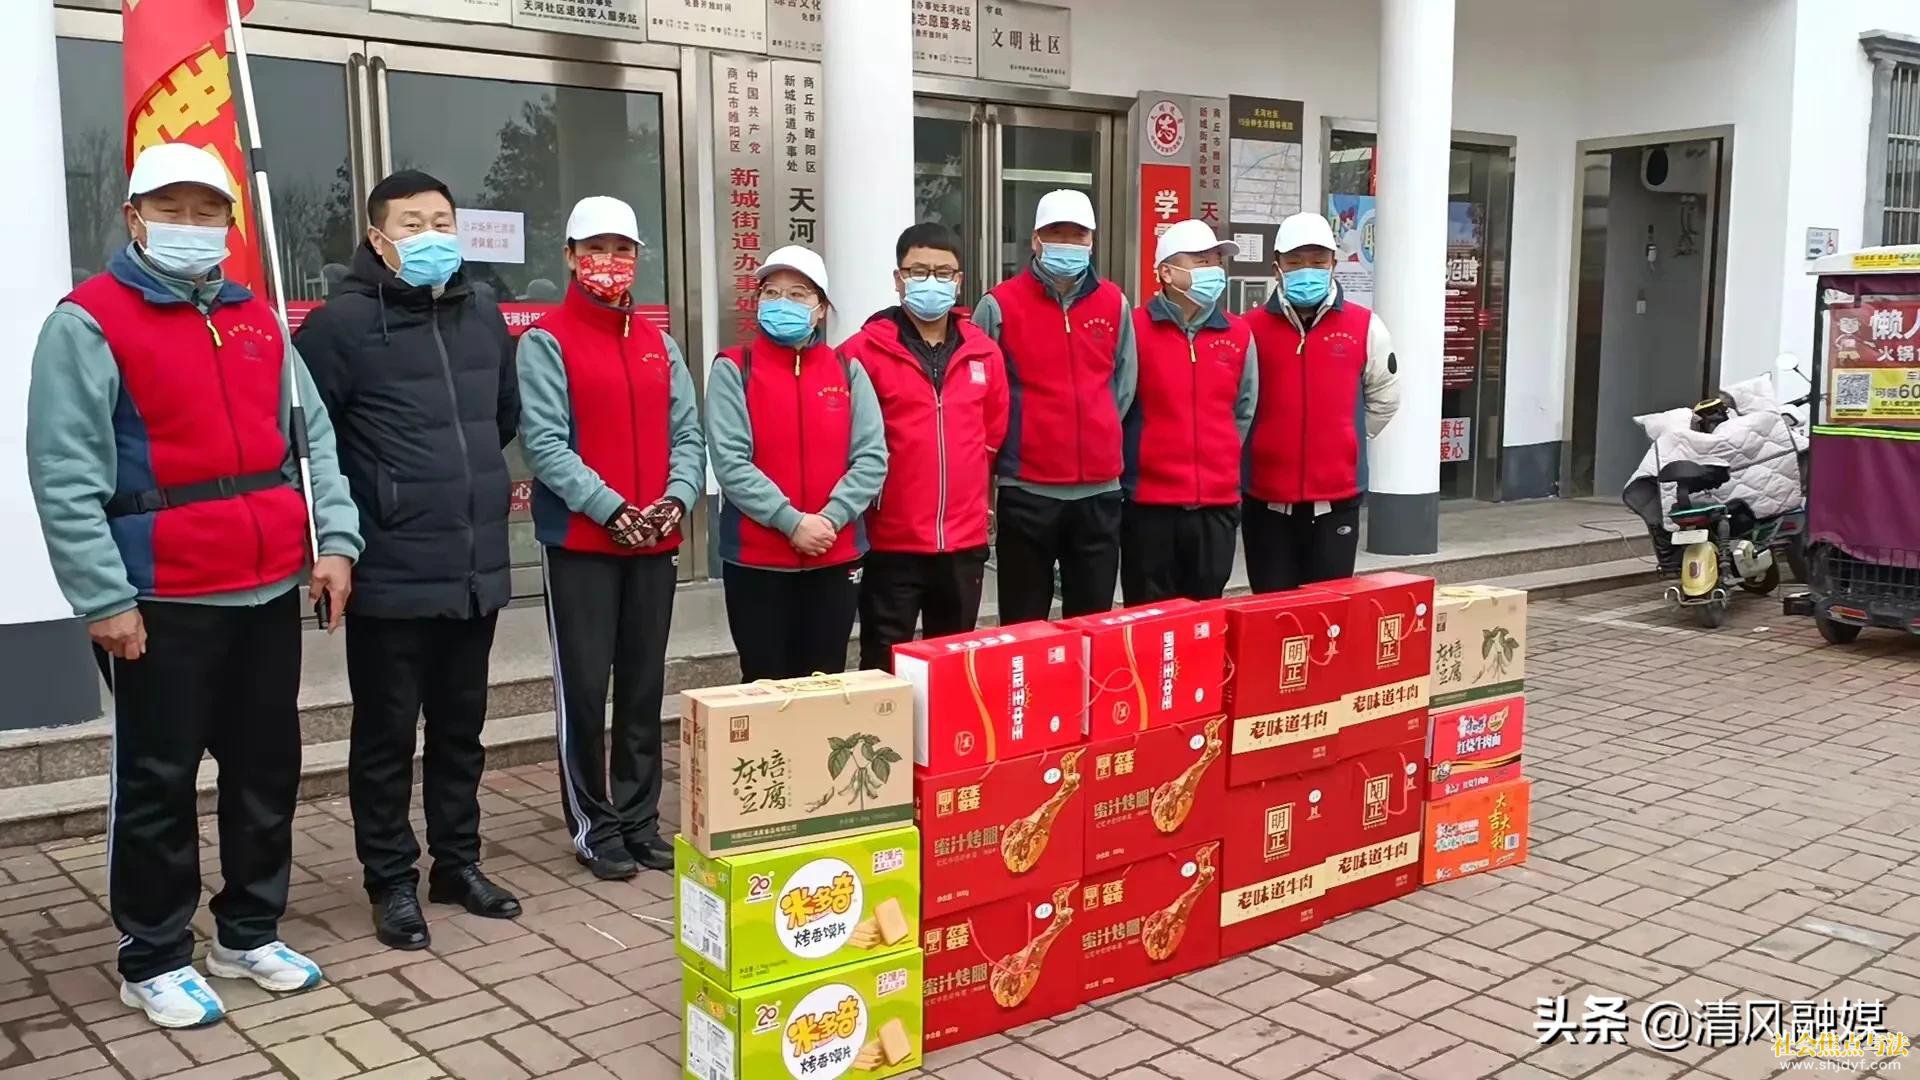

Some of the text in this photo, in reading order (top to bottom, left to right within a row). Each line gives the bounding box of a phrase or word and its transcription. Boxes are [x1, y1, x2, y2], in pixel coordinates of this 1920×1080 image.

[912, 13, 972, 32] 志愿服务站
[913, 29, 949, 40] 费开放时间
[992, 28, 1061, 54] 文明社区
[747, 69, 761, 155] 中国共产党
[784, 74, 798, 172] 新城街道办事处
[803, 76, 816, 173] 商丘市睢阳区
[1877, 346, 1920, 361] 火锅
[1283, 639, 1307, 685] 明正
[1353, 683, 1419, 713] 老味道牛肉
[1250, 710, 1328, 740] 老味道牛肉
[1267, 807, 1289, 855] 明正
[1338, 841, 1408, 874] 老味道牛肉
[780, 871, 854, 930] 米多奇
[1238, 873, 1313, 909] 老味道牛肉
[794, 922, 846, 947] 烤香馍片
[787, 995, 859, 1057] 米多奇
[800, 1046, 851, 1075] 烤香馍片
